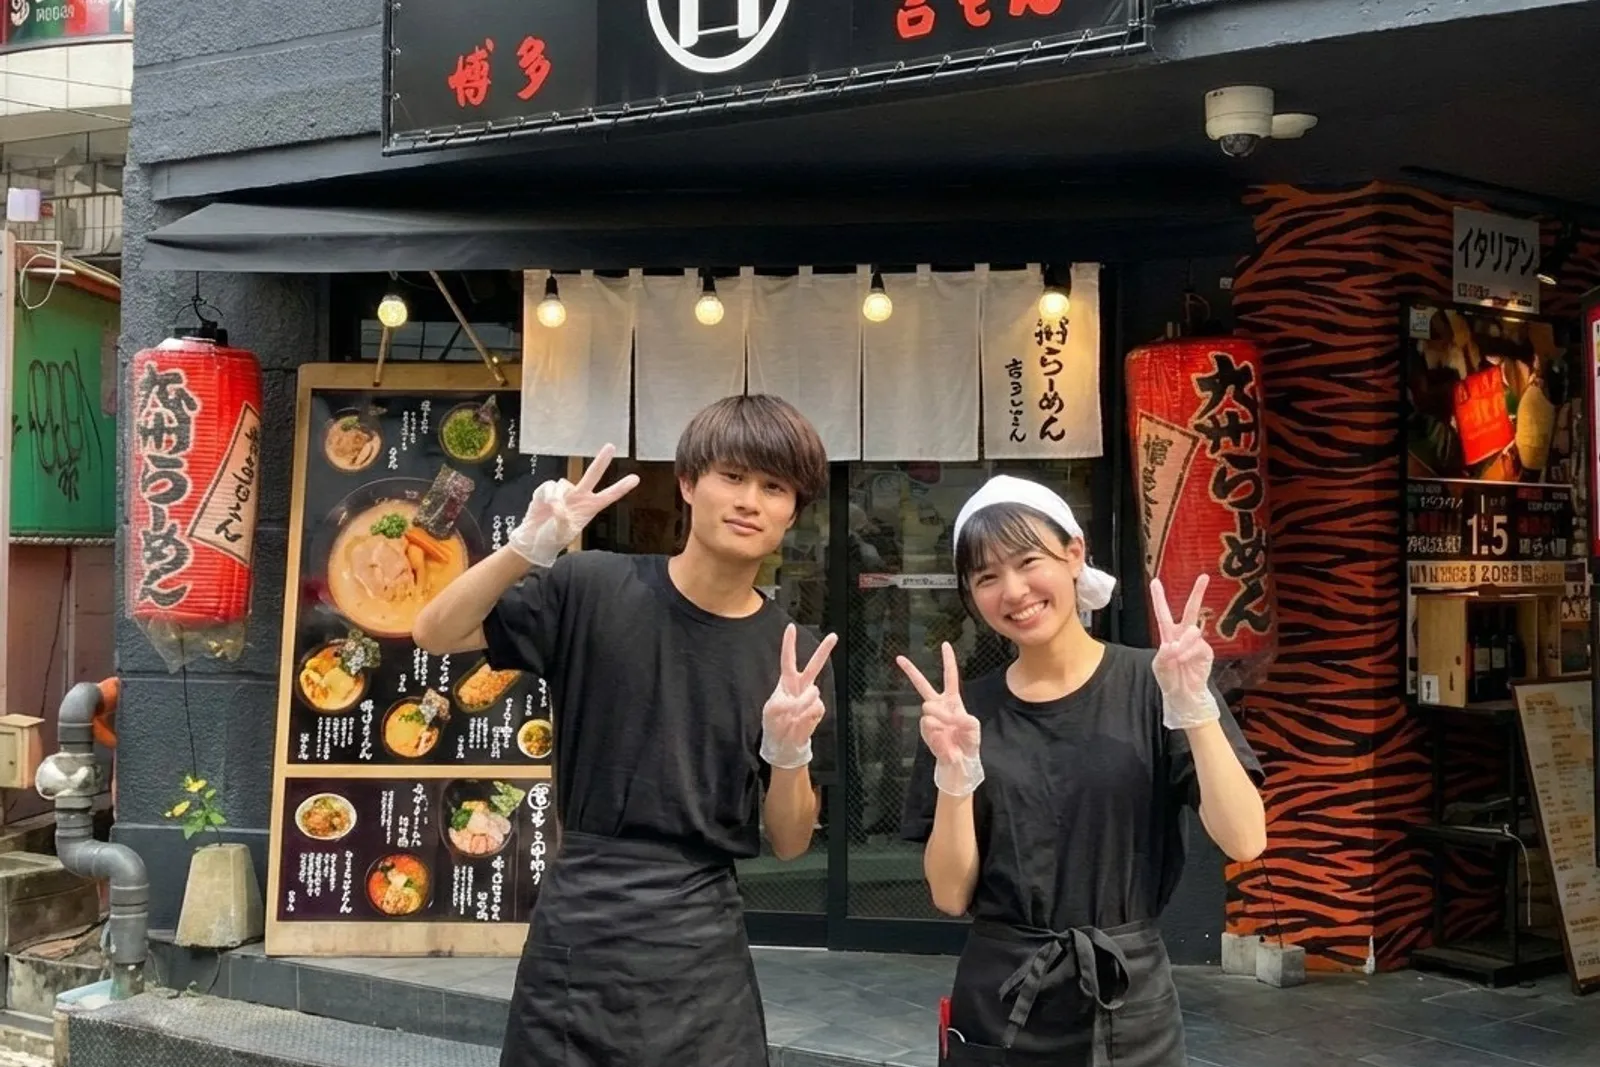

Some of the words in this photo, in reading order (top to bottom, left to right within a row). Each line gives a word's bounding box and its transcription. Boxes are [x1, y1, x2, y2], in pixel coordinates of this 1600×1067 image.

[447, 37, 552, 108] 博多
[1458, 228, 1534, 275] イタリアン
